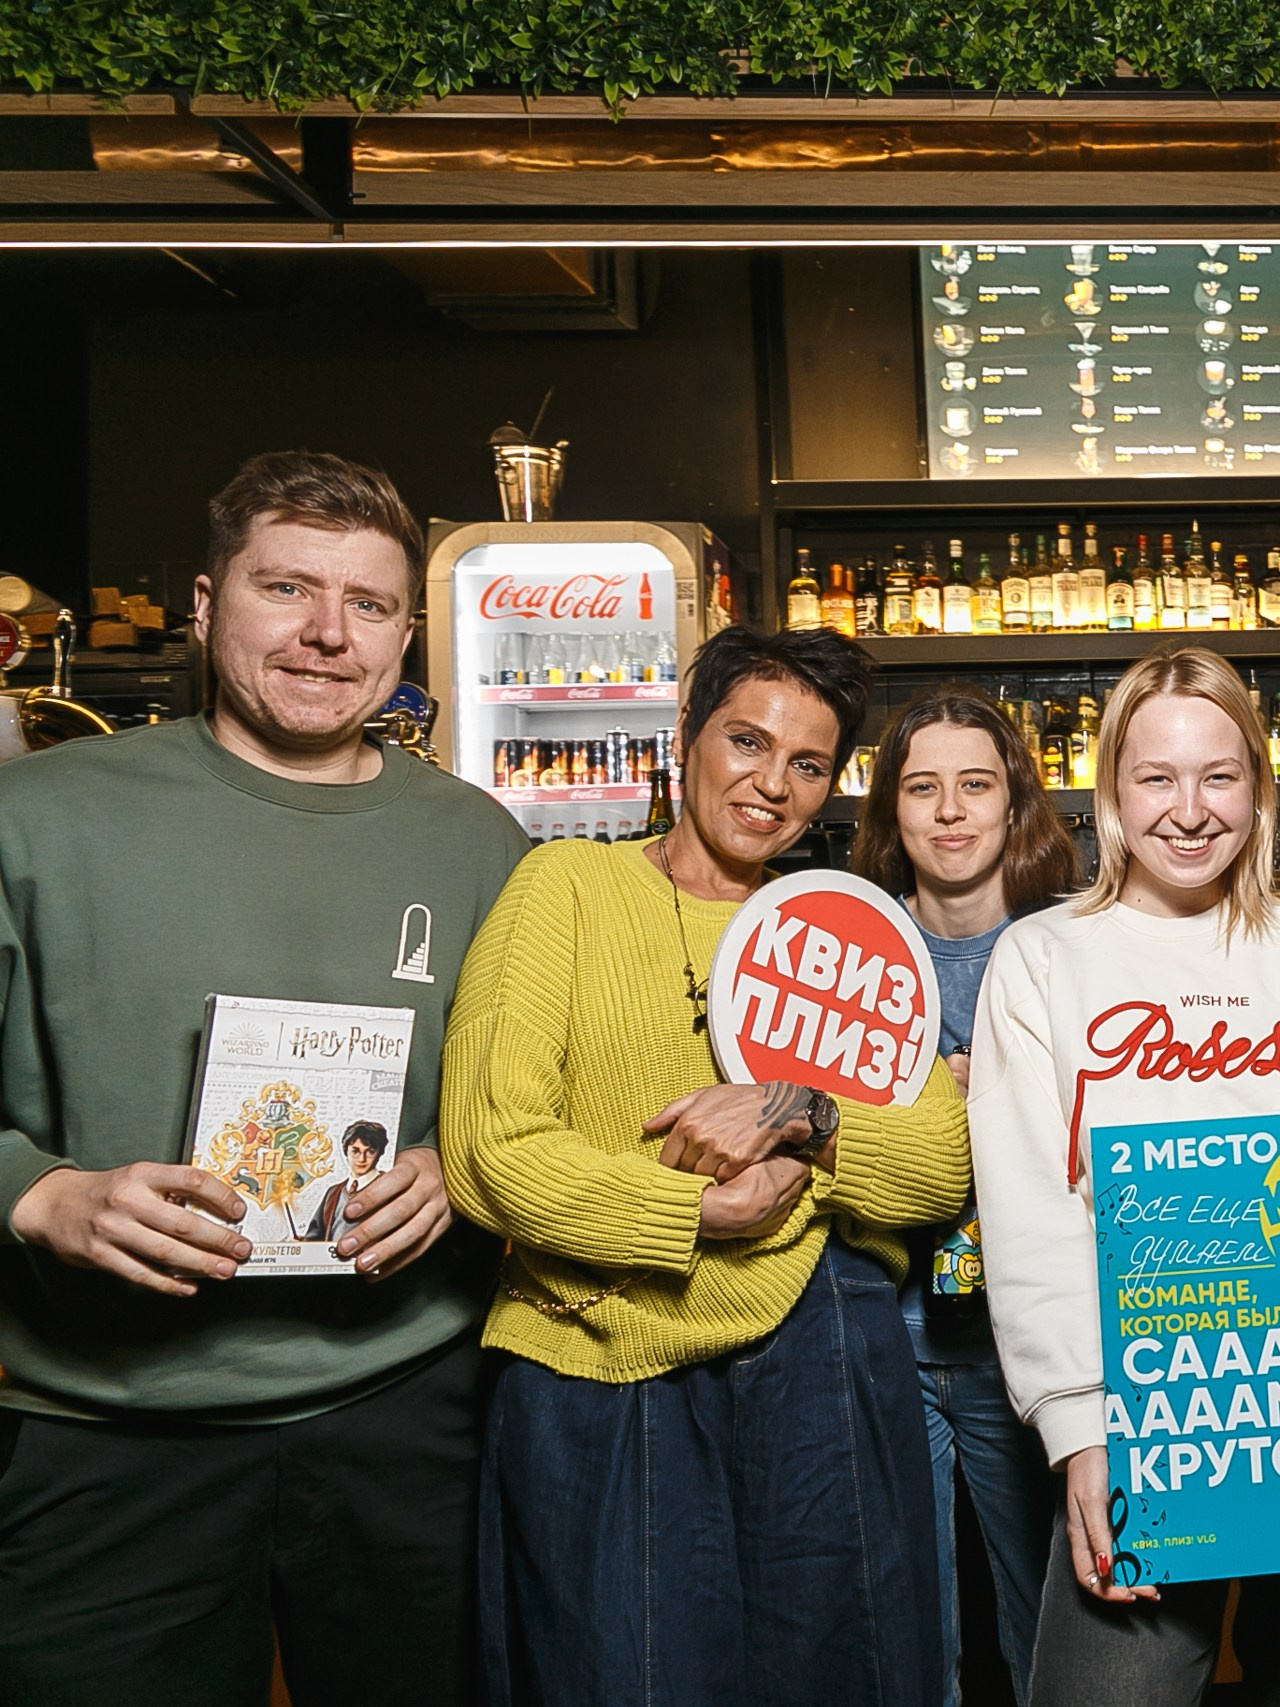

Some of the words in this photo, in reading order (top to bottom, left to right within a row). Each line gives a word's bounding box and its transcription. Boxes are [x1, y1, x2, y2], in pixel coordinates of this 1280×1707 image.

[479, 574, 630, 620] Coca-Cola
[1180, 994, 1221, 1007] WISH
[1227, 996, 1250, 1007] ME
[289, 1026, 346, 1060] Harry
[346, 1026, 405, 1064] Potter
[732, 972, 918, 1100] ПЛИЗ!
[227, 1047, 264, 1056] WORLD
[1110, 1142, 1132, 1173] 2
[1143, 1132, 1278, 1171] МЕСТО
[1188, 1195, 1266, 1229] ЕЩЕ
[251, 1246, 302, 1256] КУЛЬТЕТОВ
[1118, 1280, 1258, 1310] КОМАНДЕ,
[1119, 1313, 1230, 1337] КОТОРАЯ
[1132, 1538, 1160, 1550] КВИЗ,
[1164, 1535, 1194, 1547] ПЛИЗ!
[1196, 1533, 1217, 1544] VLG
